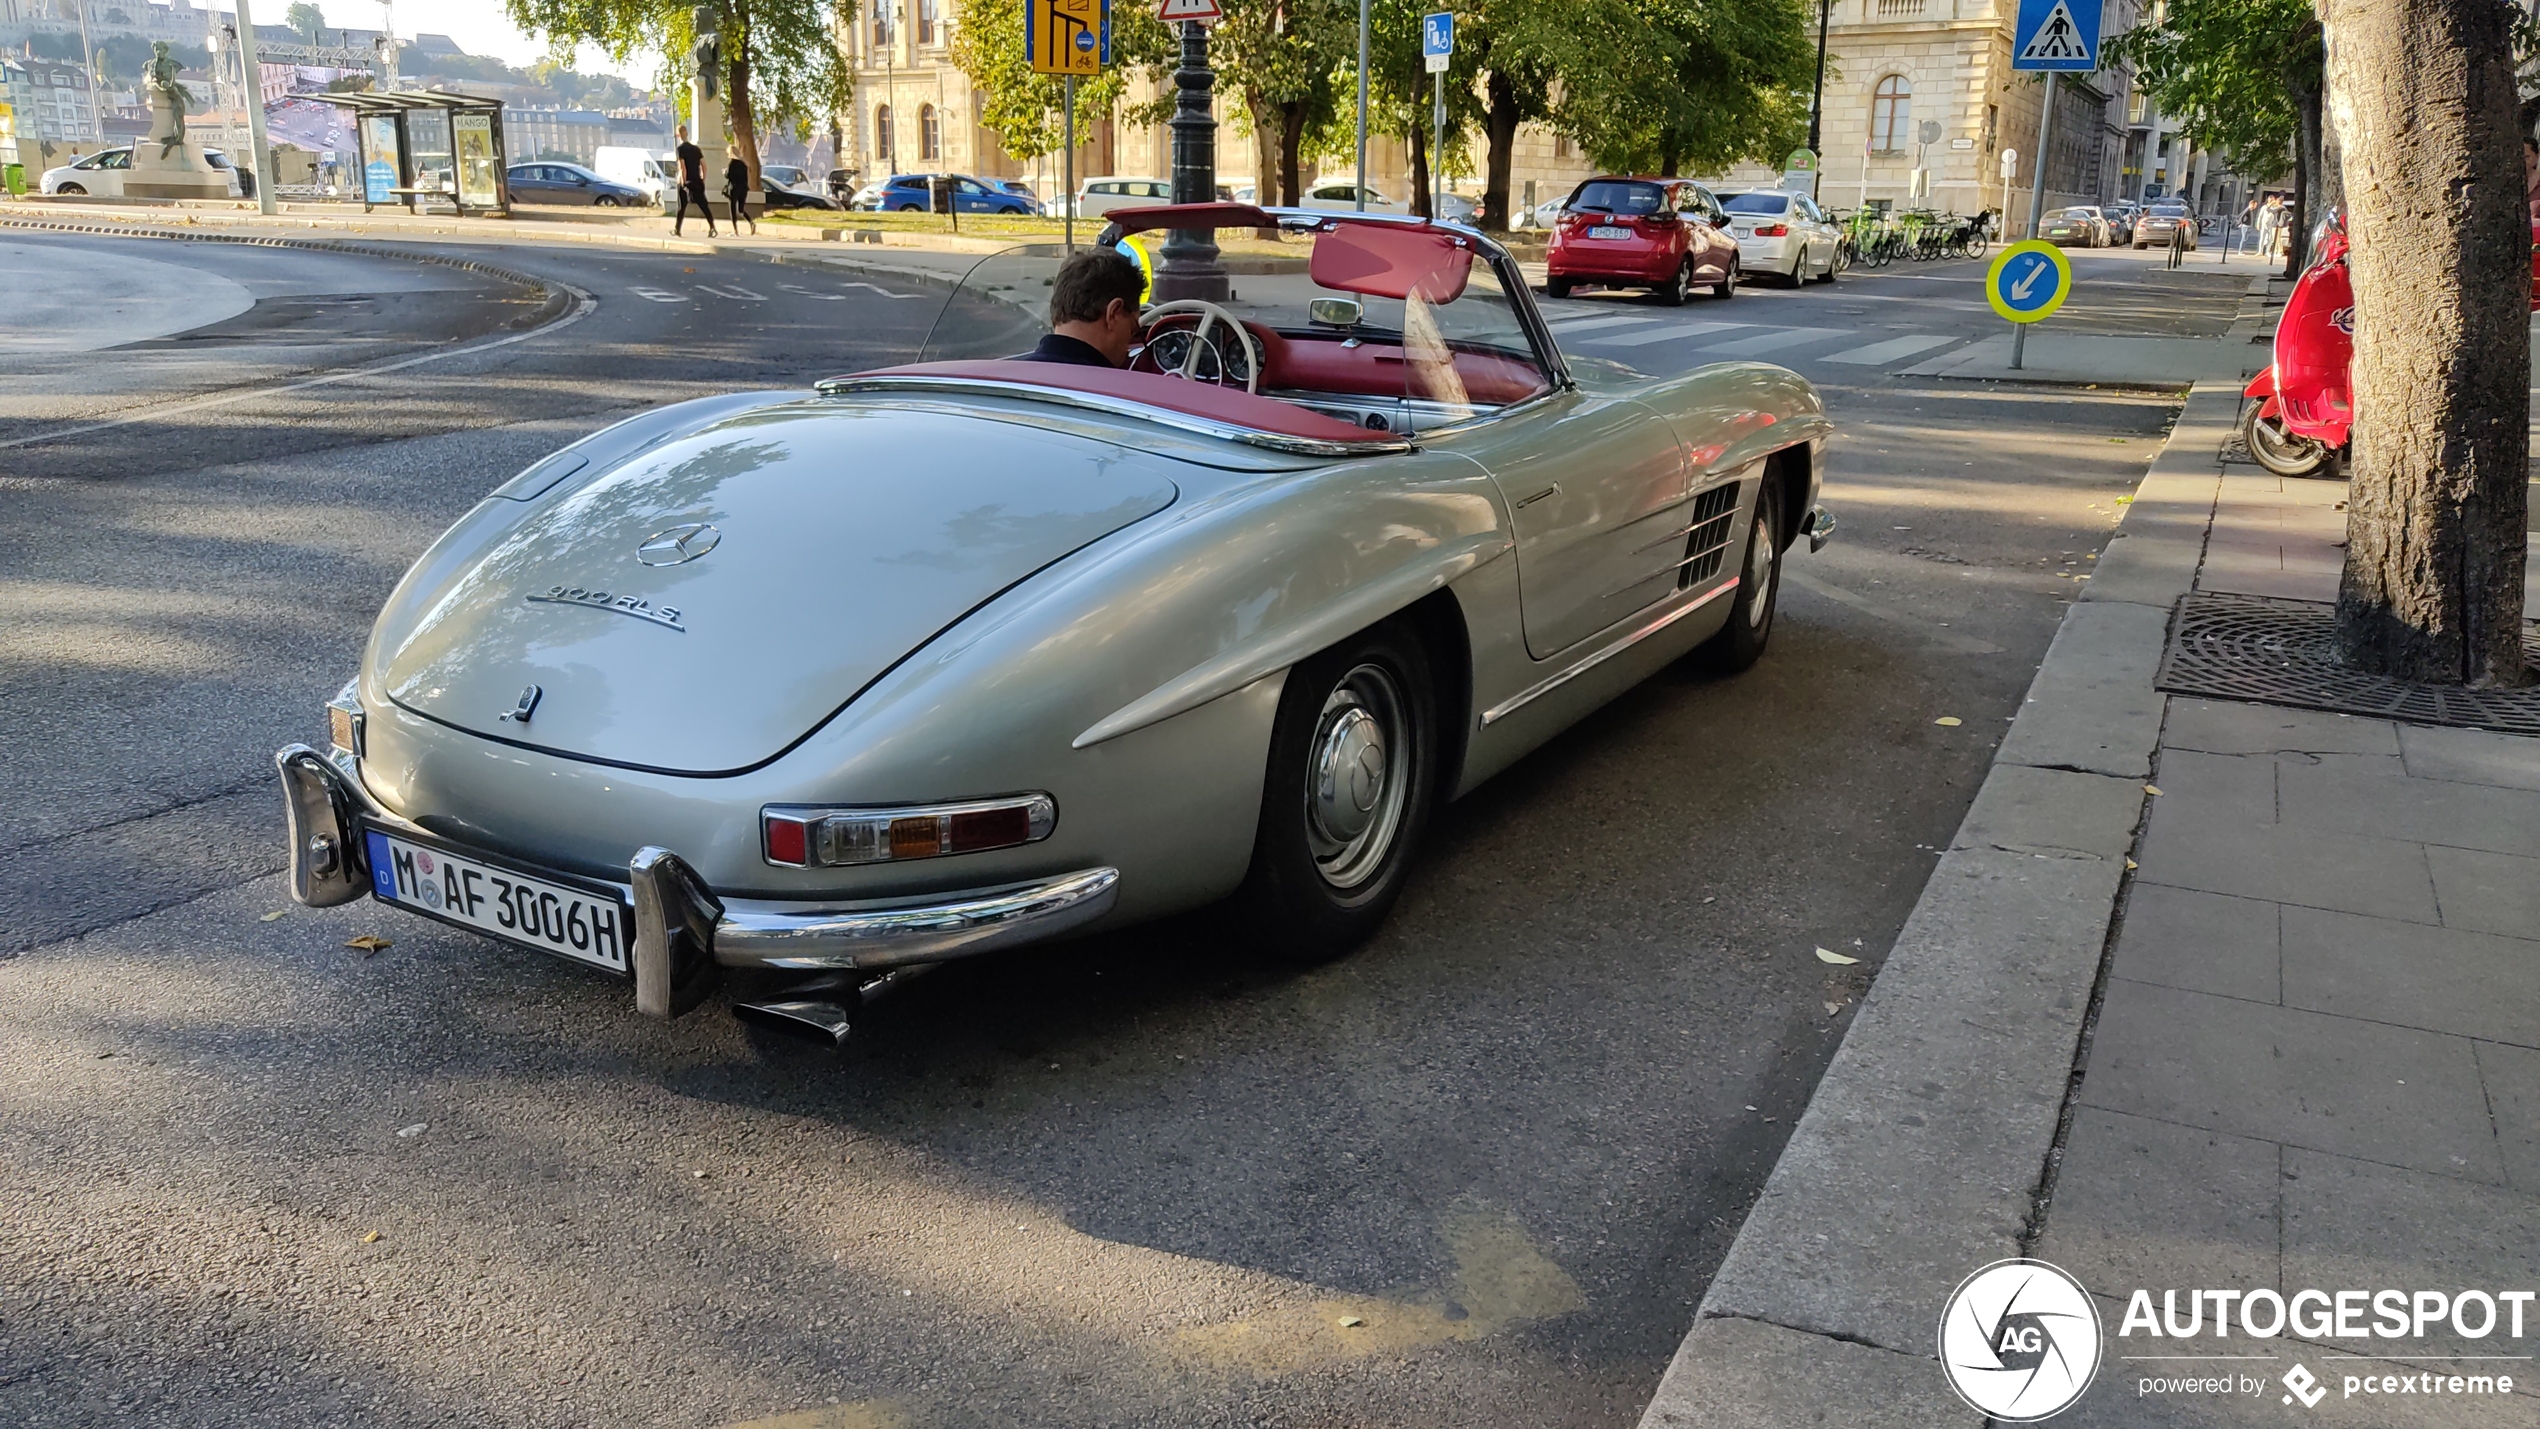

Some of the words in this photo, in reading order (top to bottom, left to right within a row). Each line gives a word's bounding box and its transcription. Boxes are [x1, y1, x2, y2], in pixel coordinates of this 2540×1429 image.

[1427, 20, 1437, 39] P
[457, 118, 488, 128] MANGO
[379, 870, 389, 885] D
[392, 846, 419, 899] M
